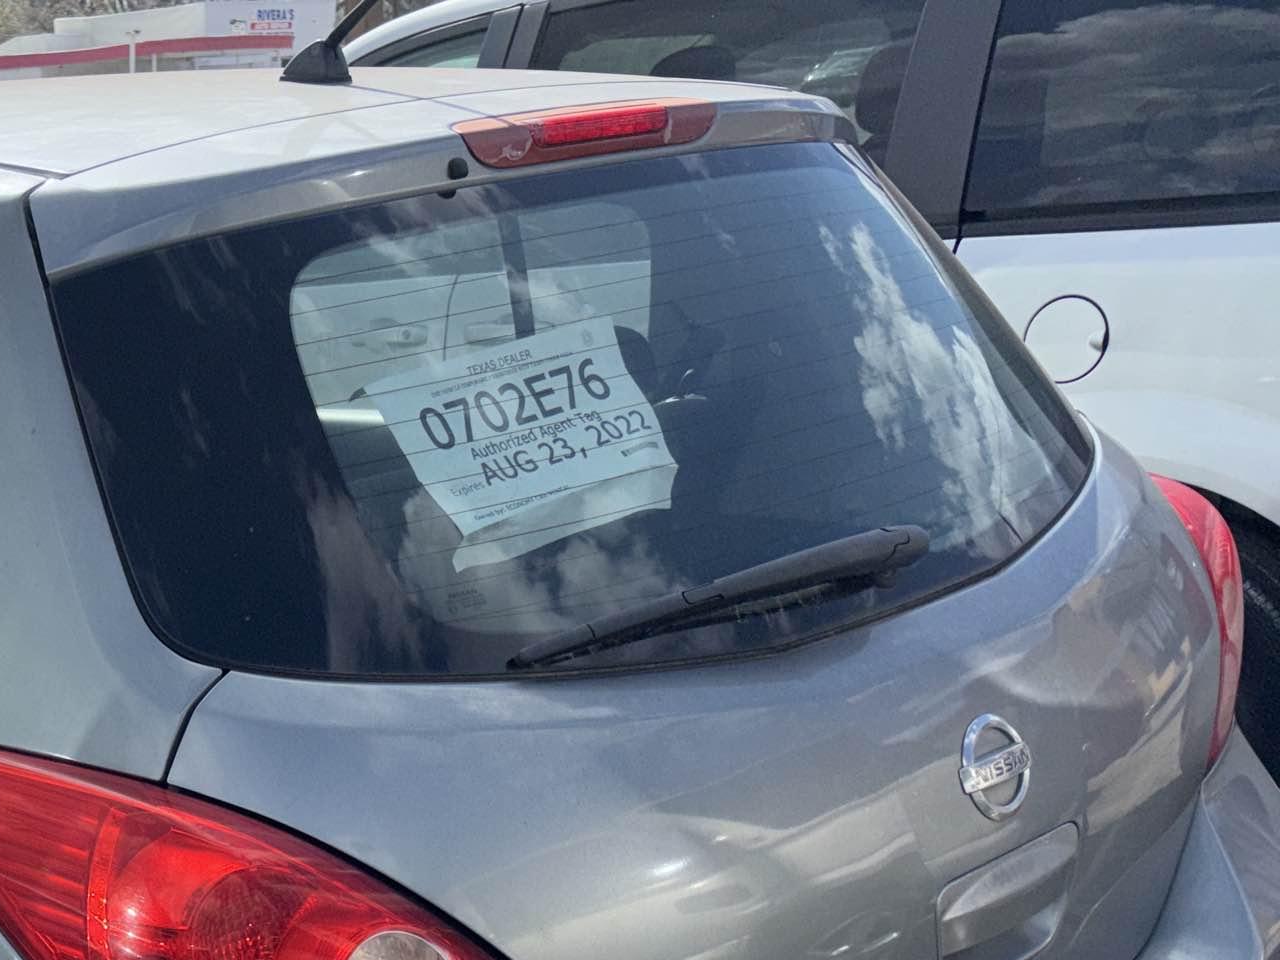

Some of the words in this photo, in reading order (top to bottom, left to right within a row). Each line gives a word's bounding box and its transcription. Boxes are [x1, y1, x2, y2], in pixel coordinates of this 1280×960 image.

[257, 9, 294, 21] RIVERA'S
[465, 359, 497, 377] TEXAS
[498, 349, 533, 368] DEALER
[420, 358, 610, 449] 0702E76
[449, 480, 485, 498] Expires
[480, 450, 539, 486] AUG
[537, 437, 588, 465] 23,
[585, 410, 652, 447] 2022
[470, 429, 537, 461] Authorized
[538, 416, 577, 438] Agent
[576, 410, 602, 424] Tag
[975, 748, 1029, 783] NISSAN
